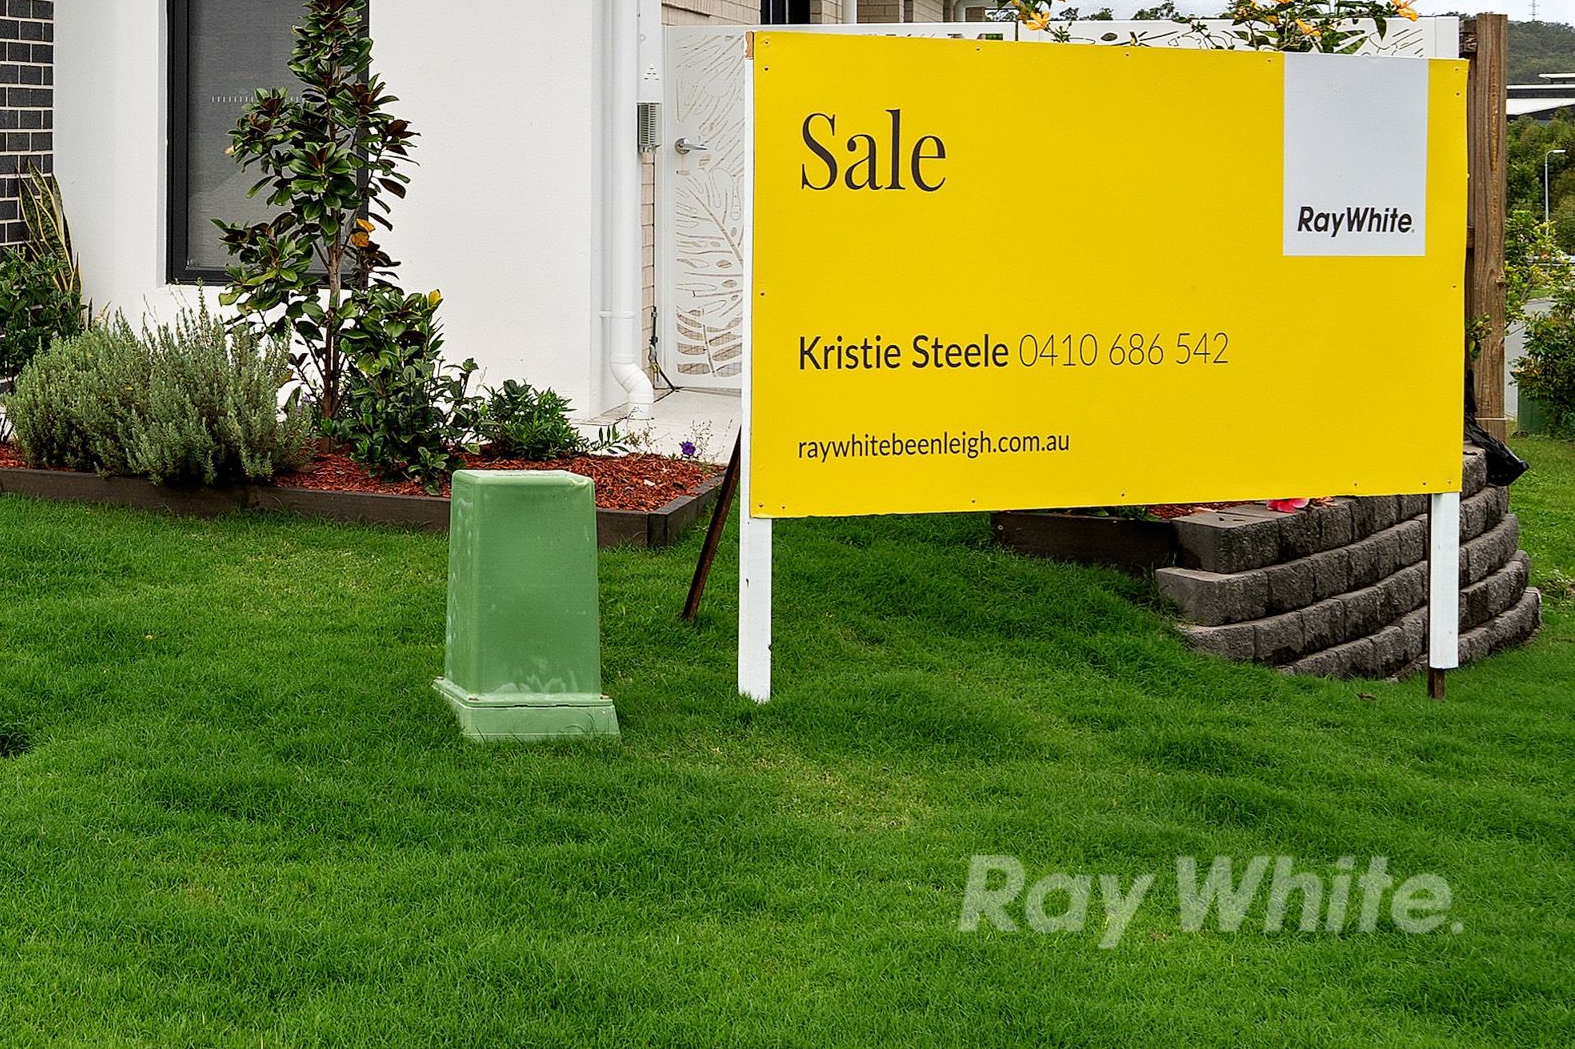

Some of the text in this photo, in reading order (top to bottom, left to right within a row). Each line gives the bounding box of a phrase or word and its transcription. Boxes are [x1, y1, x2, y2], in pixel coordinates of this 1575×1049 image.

[801, 108, 946, 192] Sale
[799, 332, 1229, 370] Kristie Steele 0410 686 542
[798, 430, 1070, 463] raywhitebeenleigh.com.au
